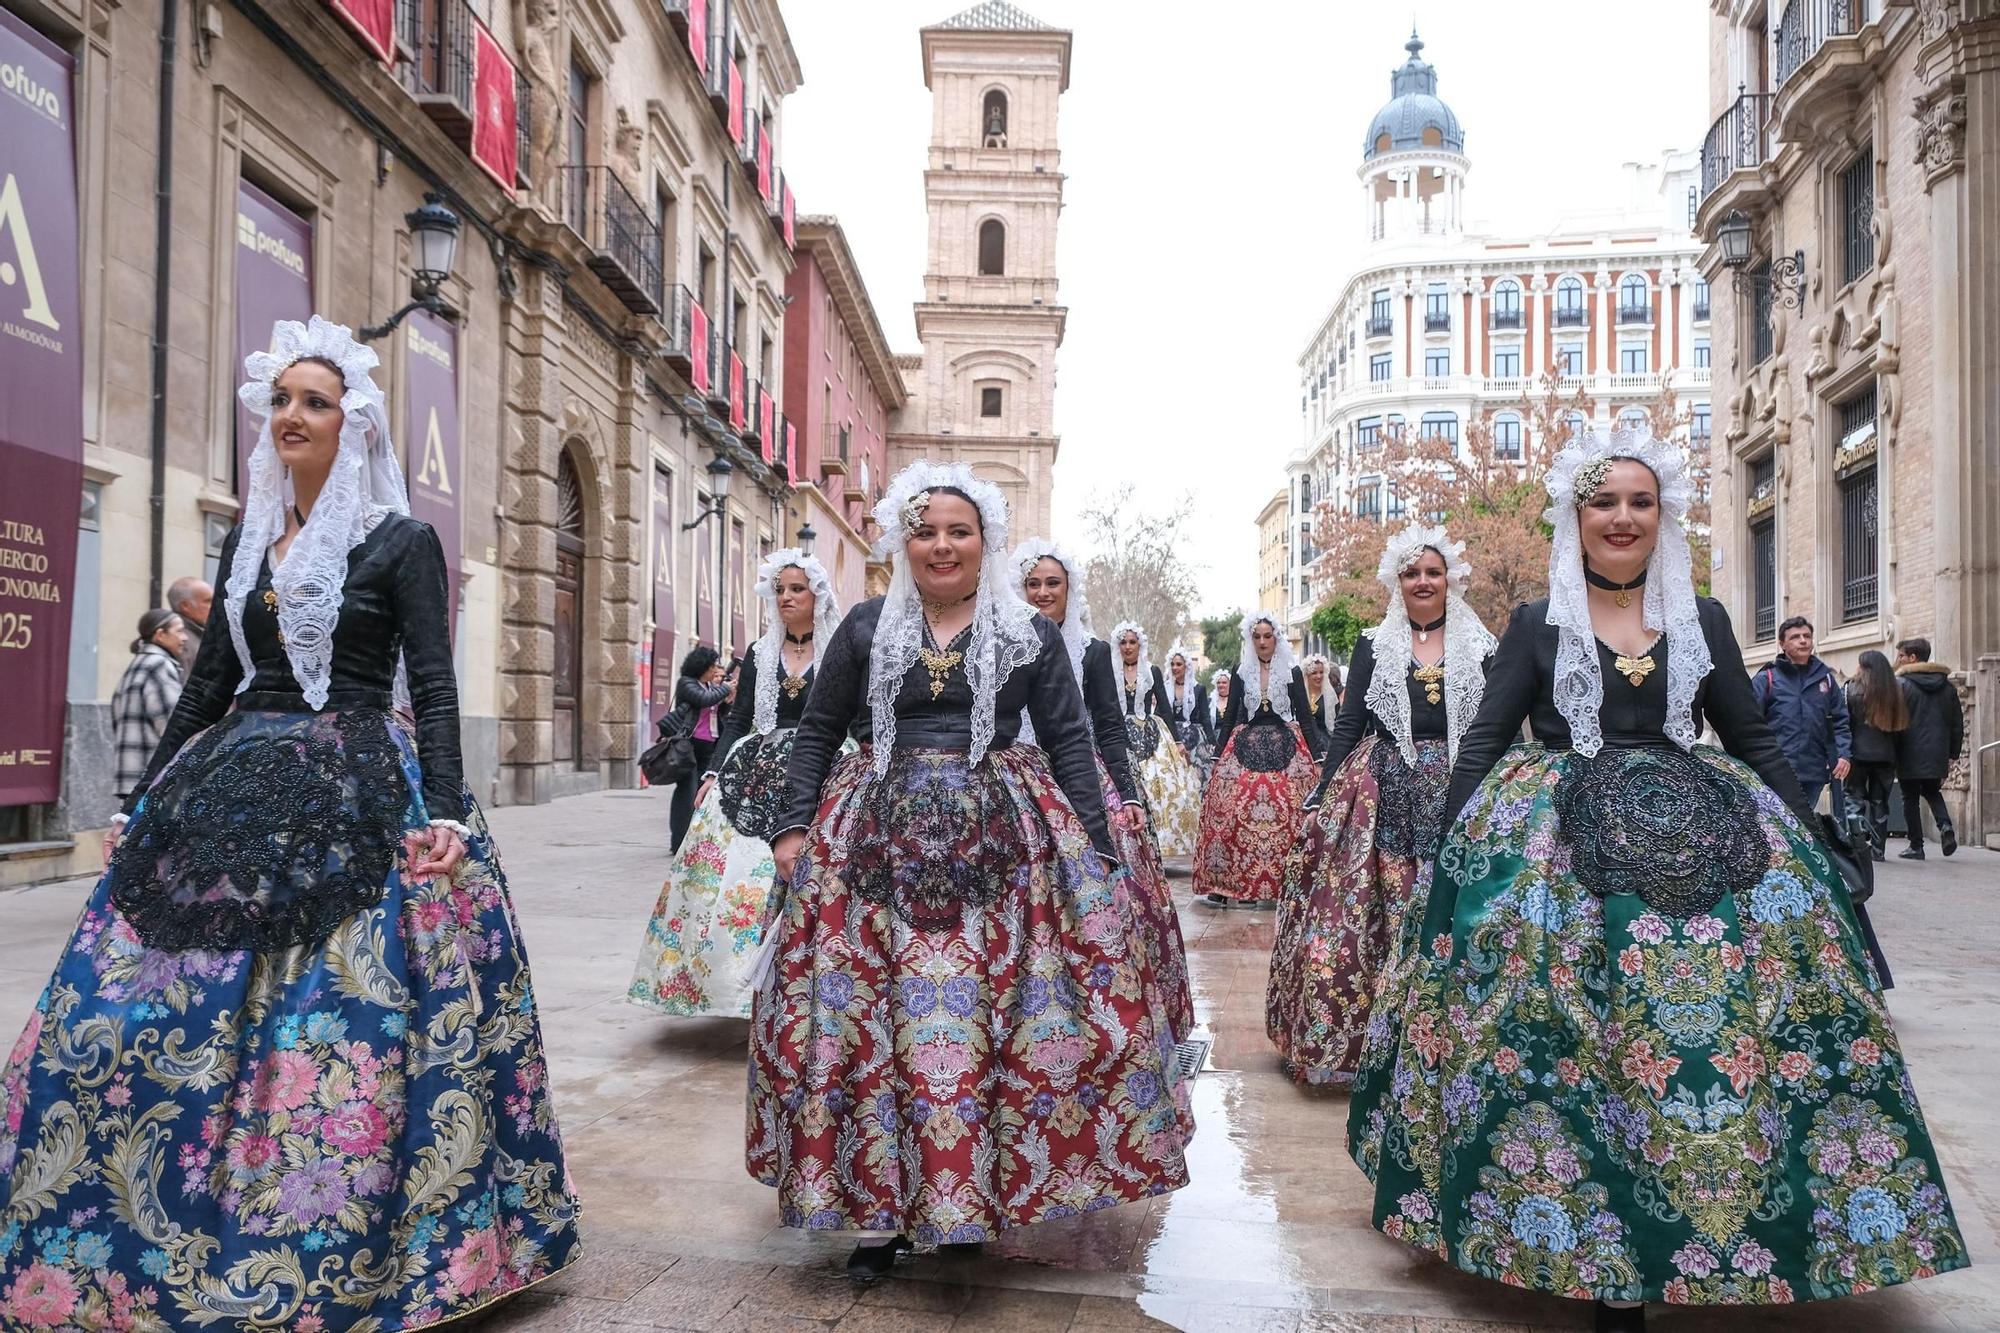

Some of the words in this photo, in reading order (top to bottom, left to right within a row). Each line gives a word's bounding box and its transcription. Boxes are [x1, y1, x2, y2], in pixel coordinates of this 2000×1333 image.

[0, 173, 60, 331] A
[257, 231, 305, 274] profusa
[417, 405, 453, 495] A
[657, 532, 672, 586] A
